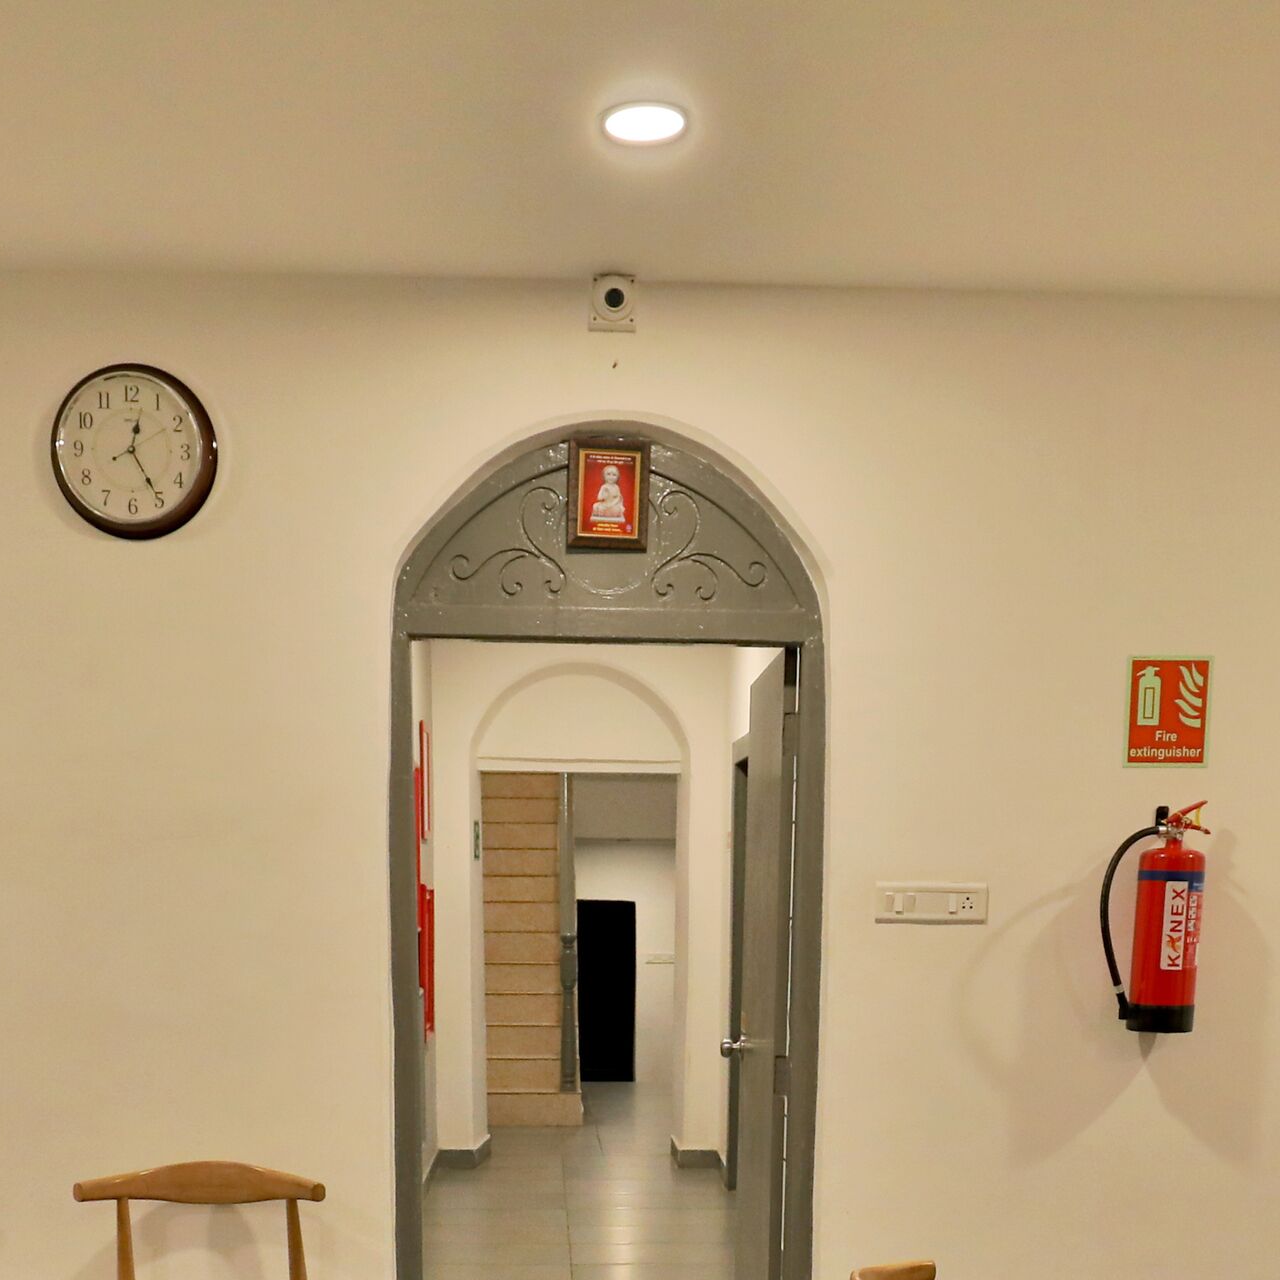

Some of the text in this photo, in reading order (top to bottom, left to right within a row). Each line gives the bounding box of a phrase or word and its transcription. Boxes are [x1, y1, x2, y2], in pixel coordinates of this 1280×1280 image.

[98, 391, 110, 409] 11
[124, 385, 139, 403] 12
[155, 392, 160, 411] 1
[79, 411, 93, 429] 10
[173, 415, 183, 433] 2
[73, 440, 84, 457] 9
[180, 443, 191, 461] 3
[81, 469, 92, 486] 8
[173, 471, 183, 489] 4
[101, 489, 111, 507] 7
[128, 497, 139, 515] 6
[154, 491, 165, 508] 5
[1155, 730, 1177, 742] Fire
[1129, 746, 1201, 760] extinguisher
